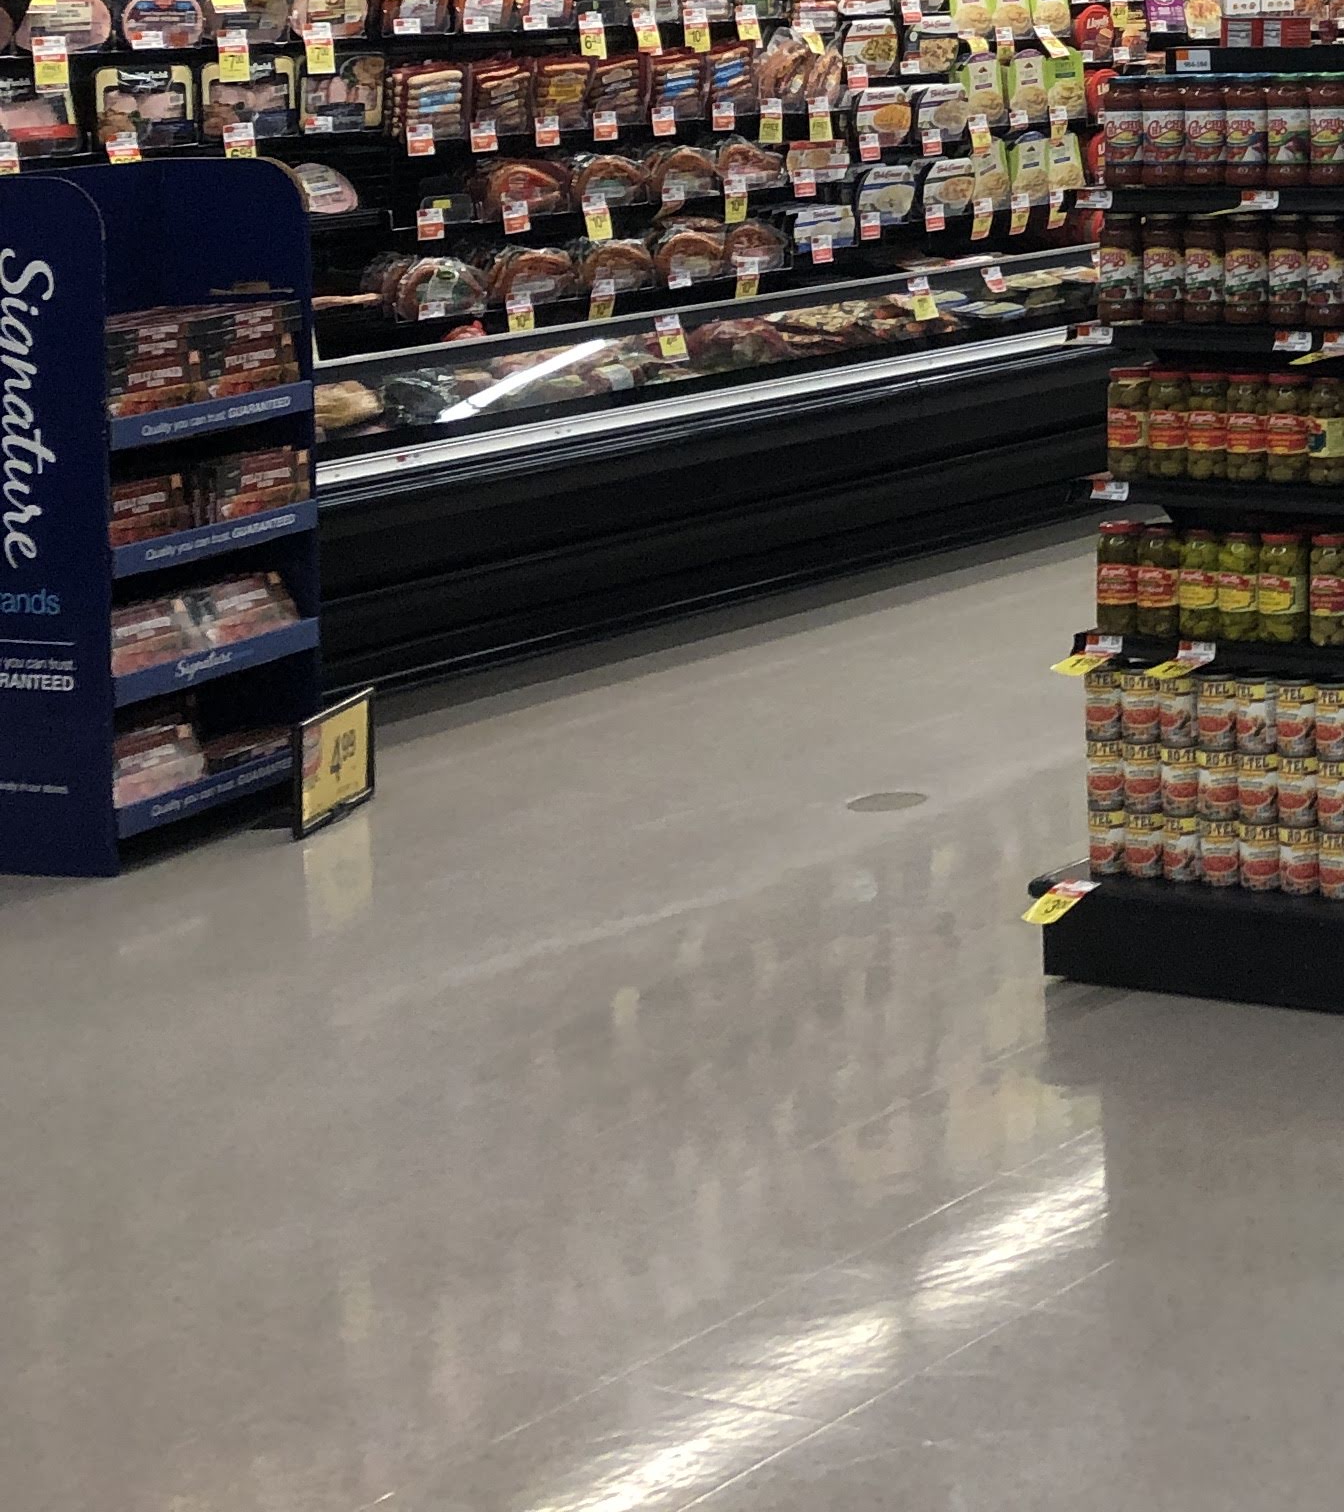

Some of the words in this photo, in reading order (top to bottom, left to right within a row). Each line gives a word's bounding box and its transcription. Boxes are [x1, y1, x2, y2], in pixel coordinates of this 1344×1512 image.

[0, 247, 60, 570] Signature
[227, 395, 292, 419] GUARANTEED
[174, 651, 233, 682] Signature
